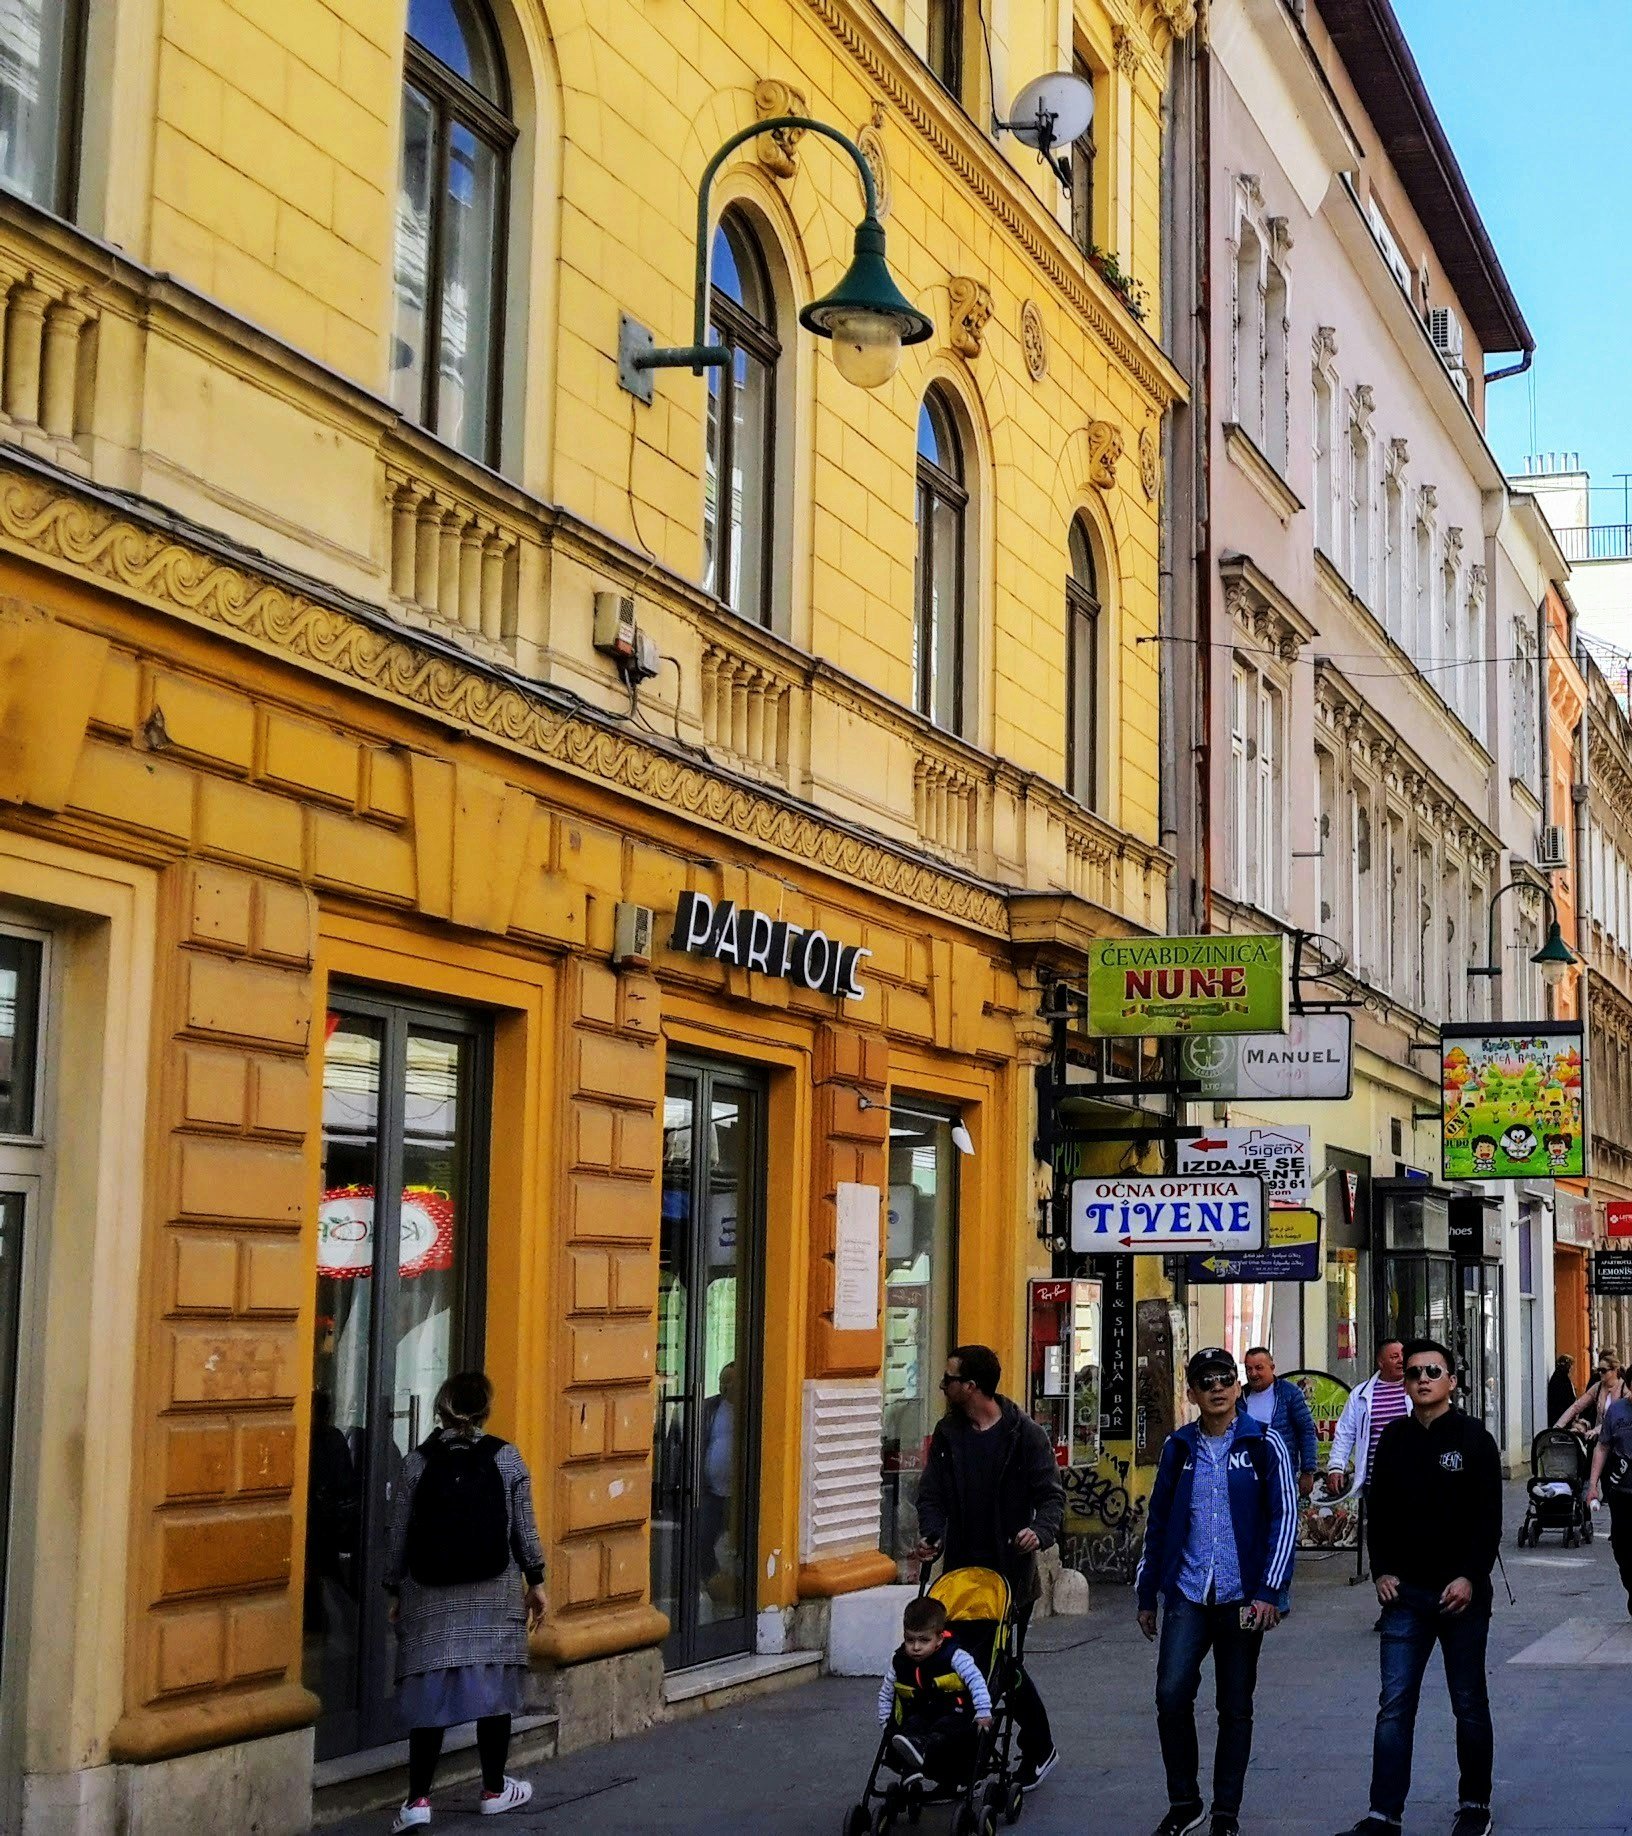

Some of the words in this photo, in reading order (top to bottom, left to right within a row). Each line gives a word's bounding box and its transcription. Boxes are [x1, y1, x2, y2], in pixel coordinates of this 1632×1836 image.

[1100, 942, 1269, 967] ĆEVABDŽINICA
[1123, 966, 1248, 1001] NUNE
[1481, 1037, 1549, 1054] Kindergarten
[1183, 1159, 1267, 1173] IZDAJE
[1275, 1157, 1305, 1169] SE
[1095, 1181, 1156, 1198] OČNA
[1160, 1183, 1239, 1198] OPTIKA
[1290, 1179, 1305, 1189] 61
[1449, 1226, 1473, 1236] hoes
[1112, 1298, 1125, 1308] &
[1113, 1316, 1124, 1382] SHISHA
[1112, 1394, 1124, 1426] BAR
